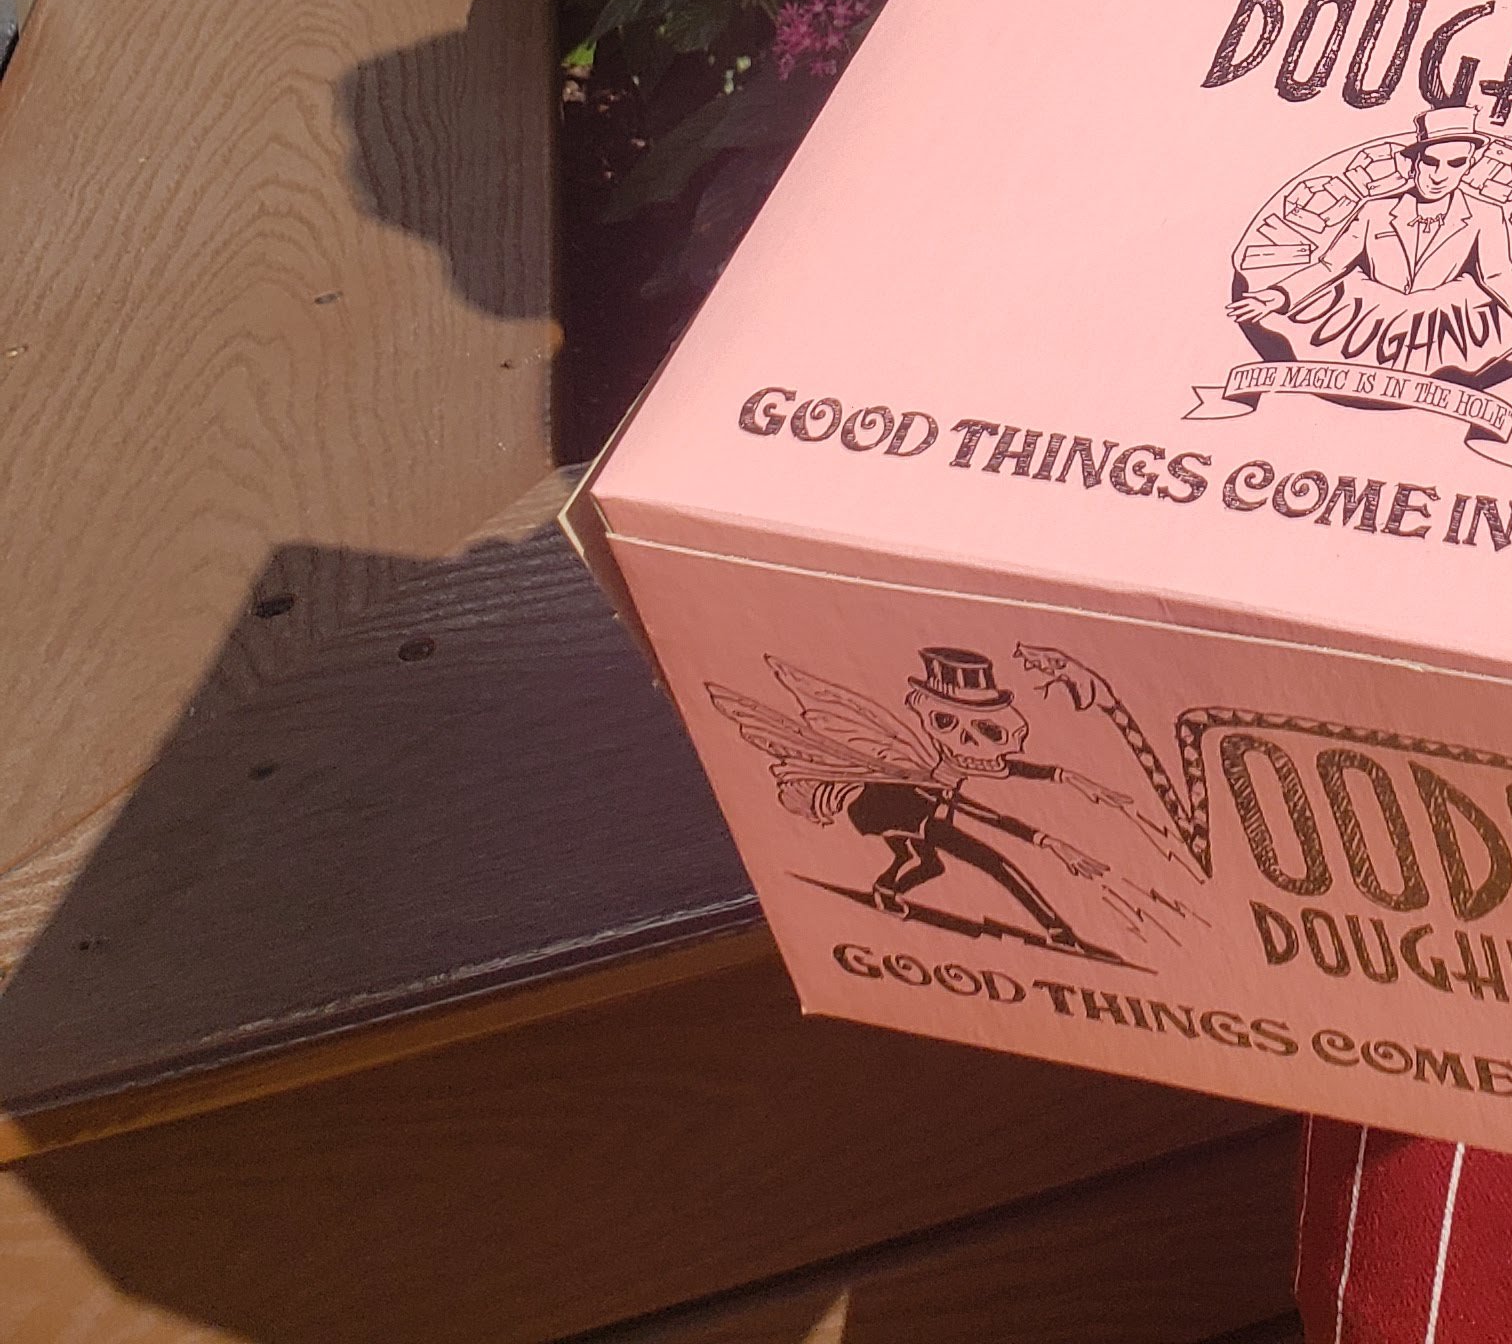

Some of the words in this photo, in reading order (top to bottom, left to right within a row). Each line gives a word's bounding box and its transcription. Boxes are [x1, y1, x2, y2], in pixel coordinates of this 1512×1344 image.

[1288, 281, 1501, 372] DOUGHNUT
[1233, 366, 1277, 391] THE
[1280, 366, 1350, 391] MAGIC
[1353, 371, 1376, 394] IS
[1380, 376, 1411, 400] IN
[1413, 382, 1452, 409] THE
[738, 386, 940, 458] GOOD
[948, 418, 1213, 504] THINGS
[1222, 459, 1441, 540] COME
[832, 942, 1026, 1005] GOOD
[1031, 978, 1300, 1057] THINGS
